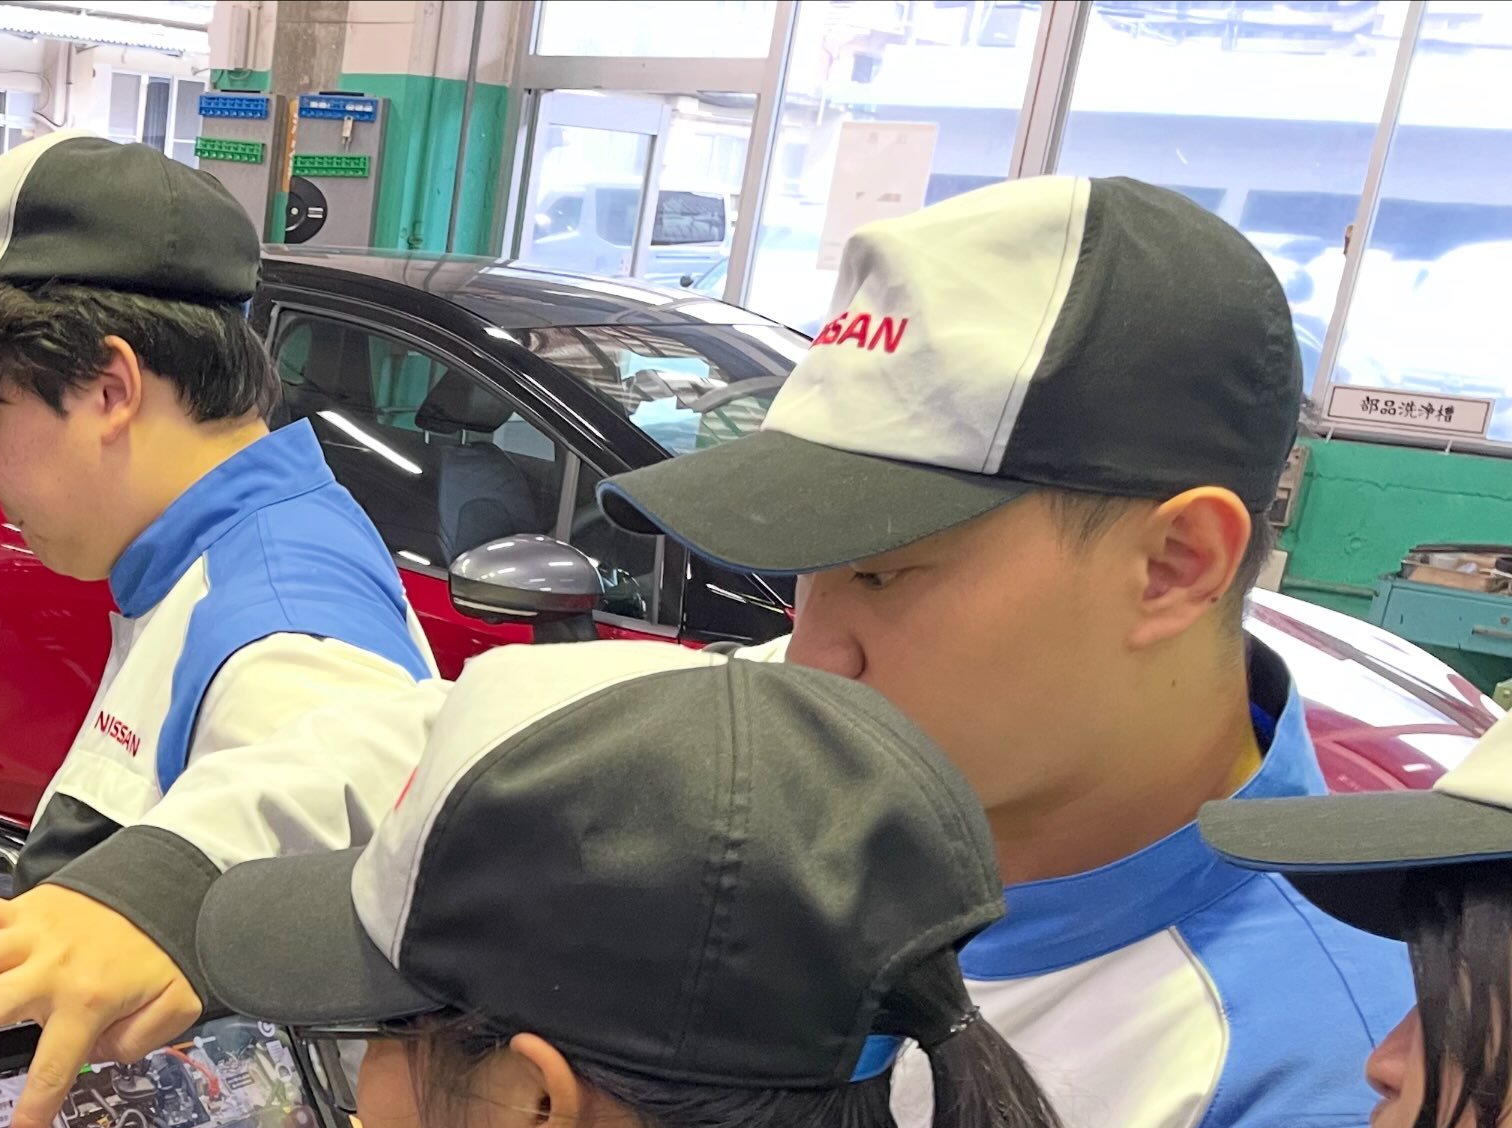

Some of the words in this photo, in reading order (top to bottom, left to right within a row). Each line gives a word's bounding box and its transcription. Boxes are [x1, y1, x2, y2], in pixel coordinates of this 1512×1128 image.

[1360, 396, 1455, 423] 部品洗浄槽
[94, 711, 140, 757] NISSAN
